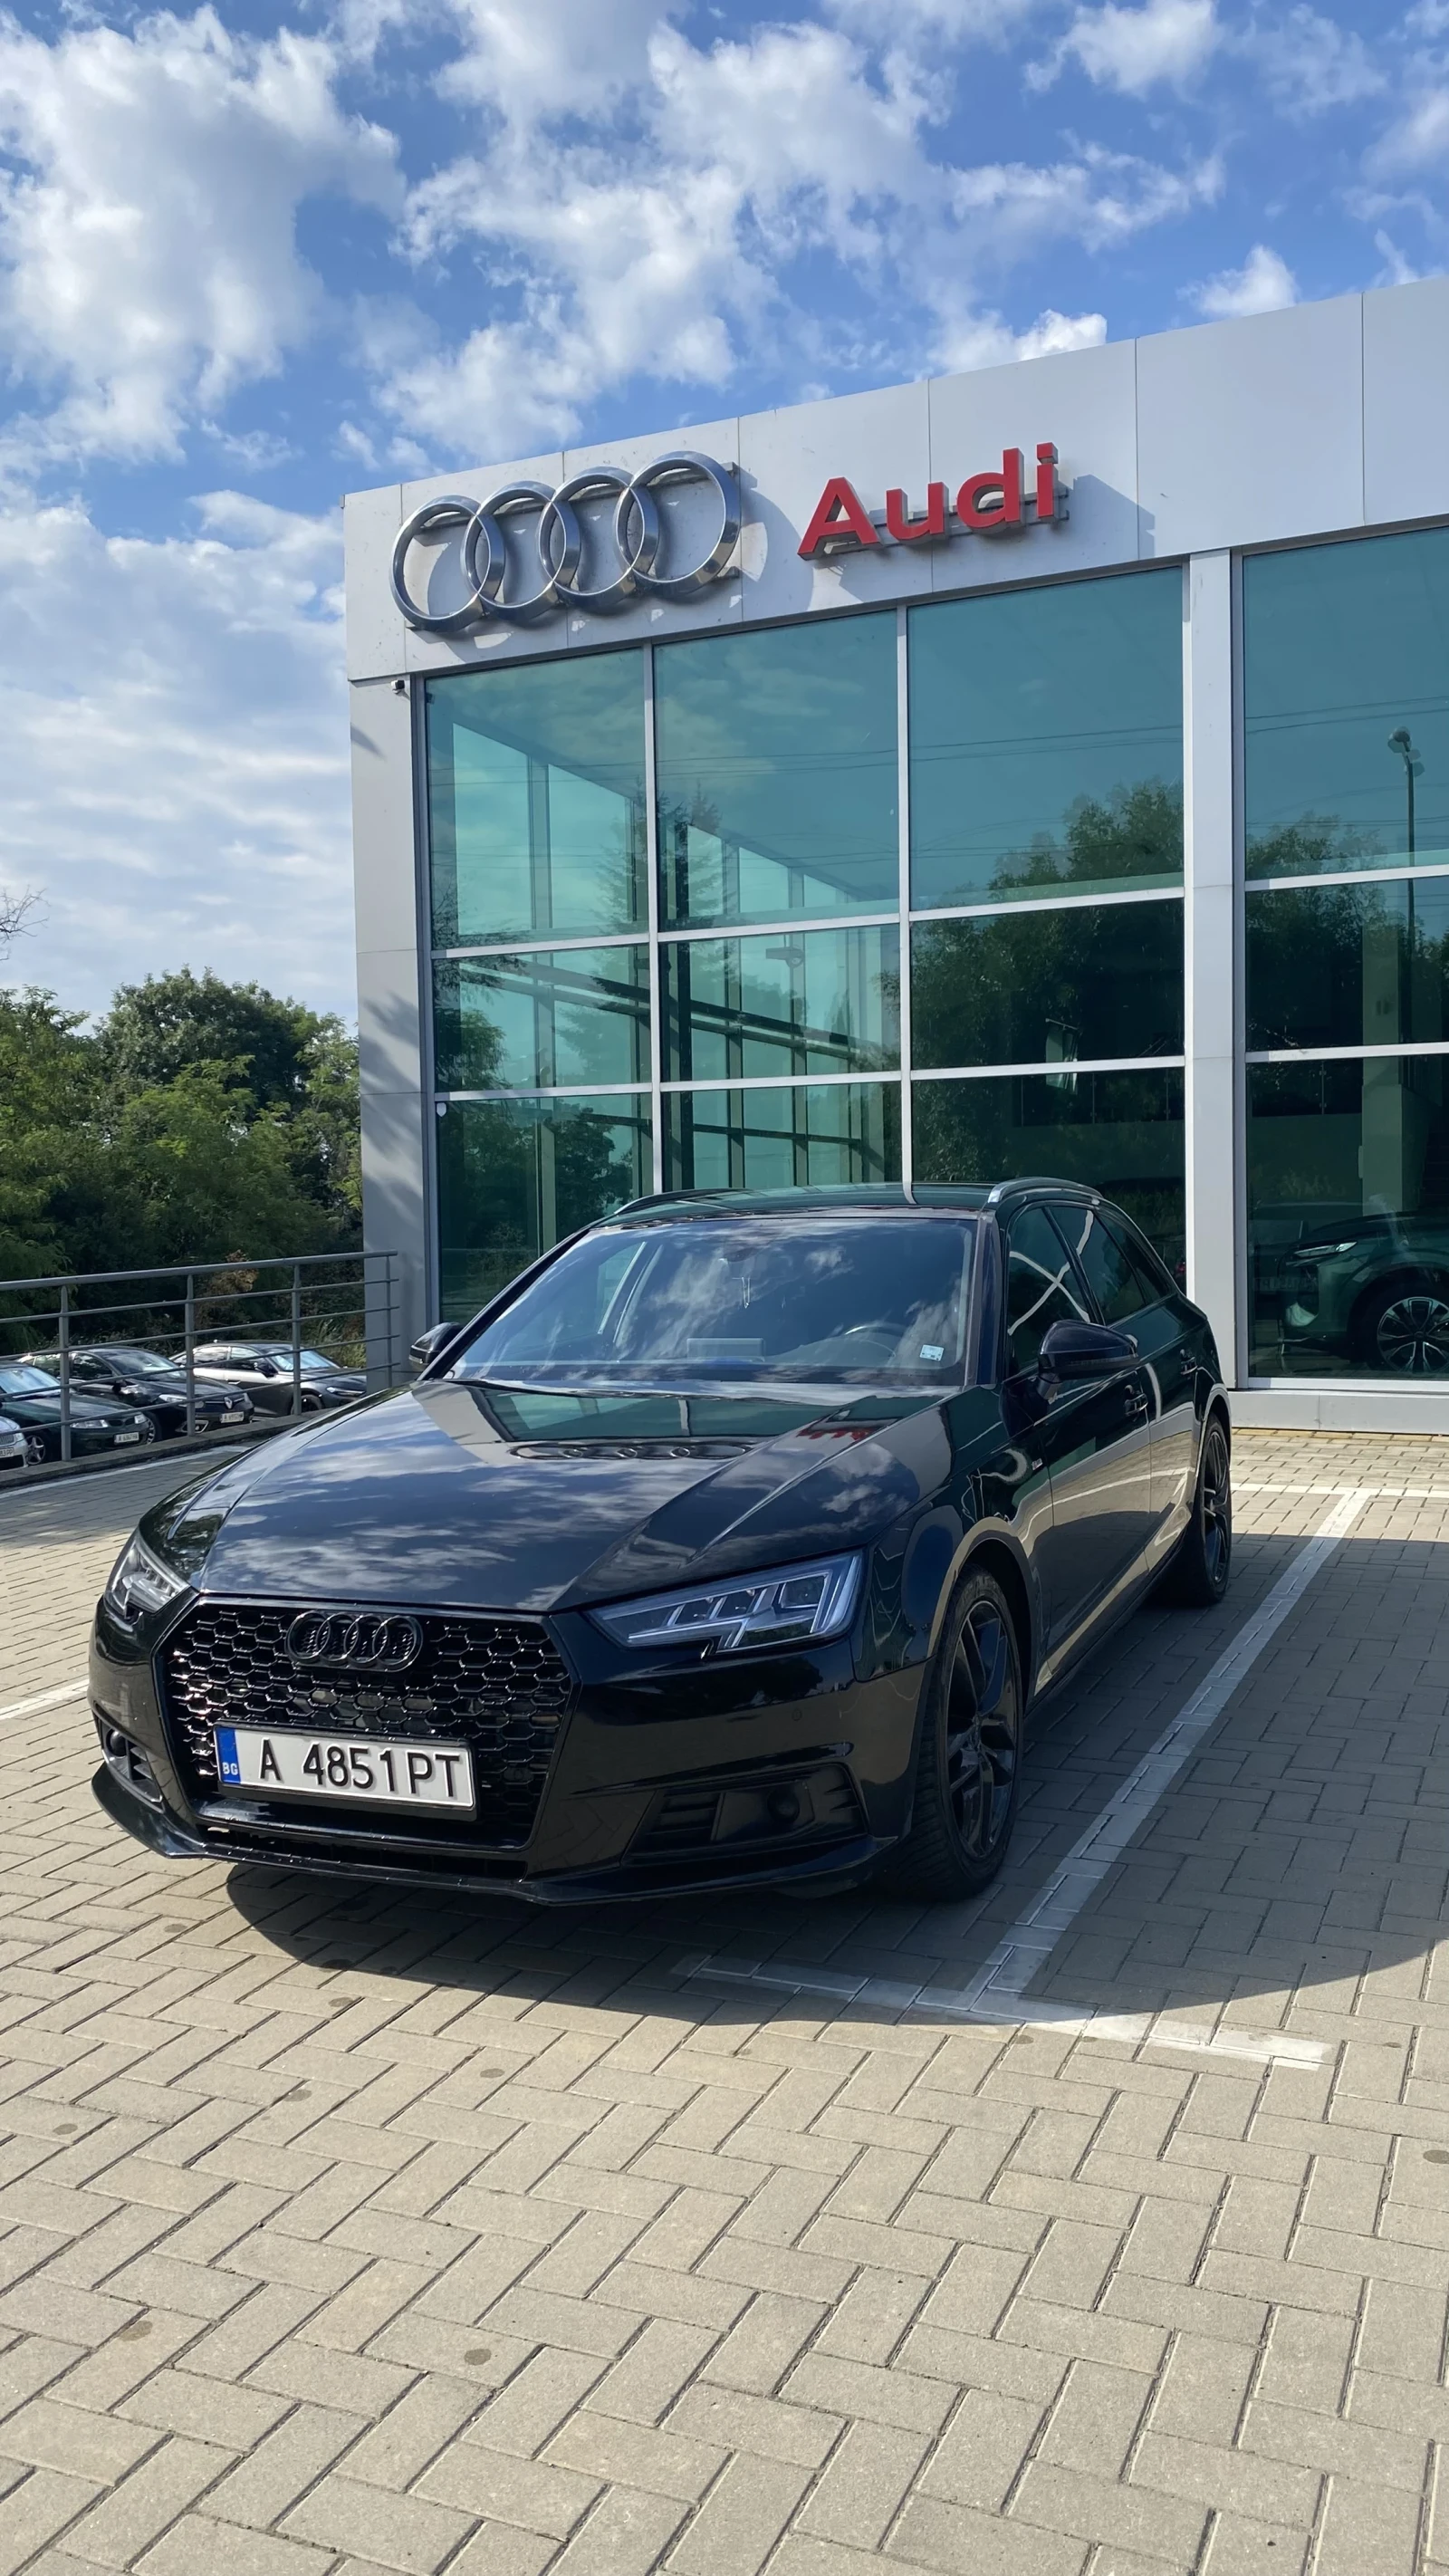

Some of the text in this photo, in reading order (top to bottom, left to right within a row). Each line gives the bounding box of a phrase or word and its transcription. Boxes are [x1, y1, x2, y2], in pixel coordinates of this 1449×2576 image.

[797, 442, 1058, 560] Audi
[222, 1762, 238, 1775] BG
[259, 1738, 282, 1781] A
